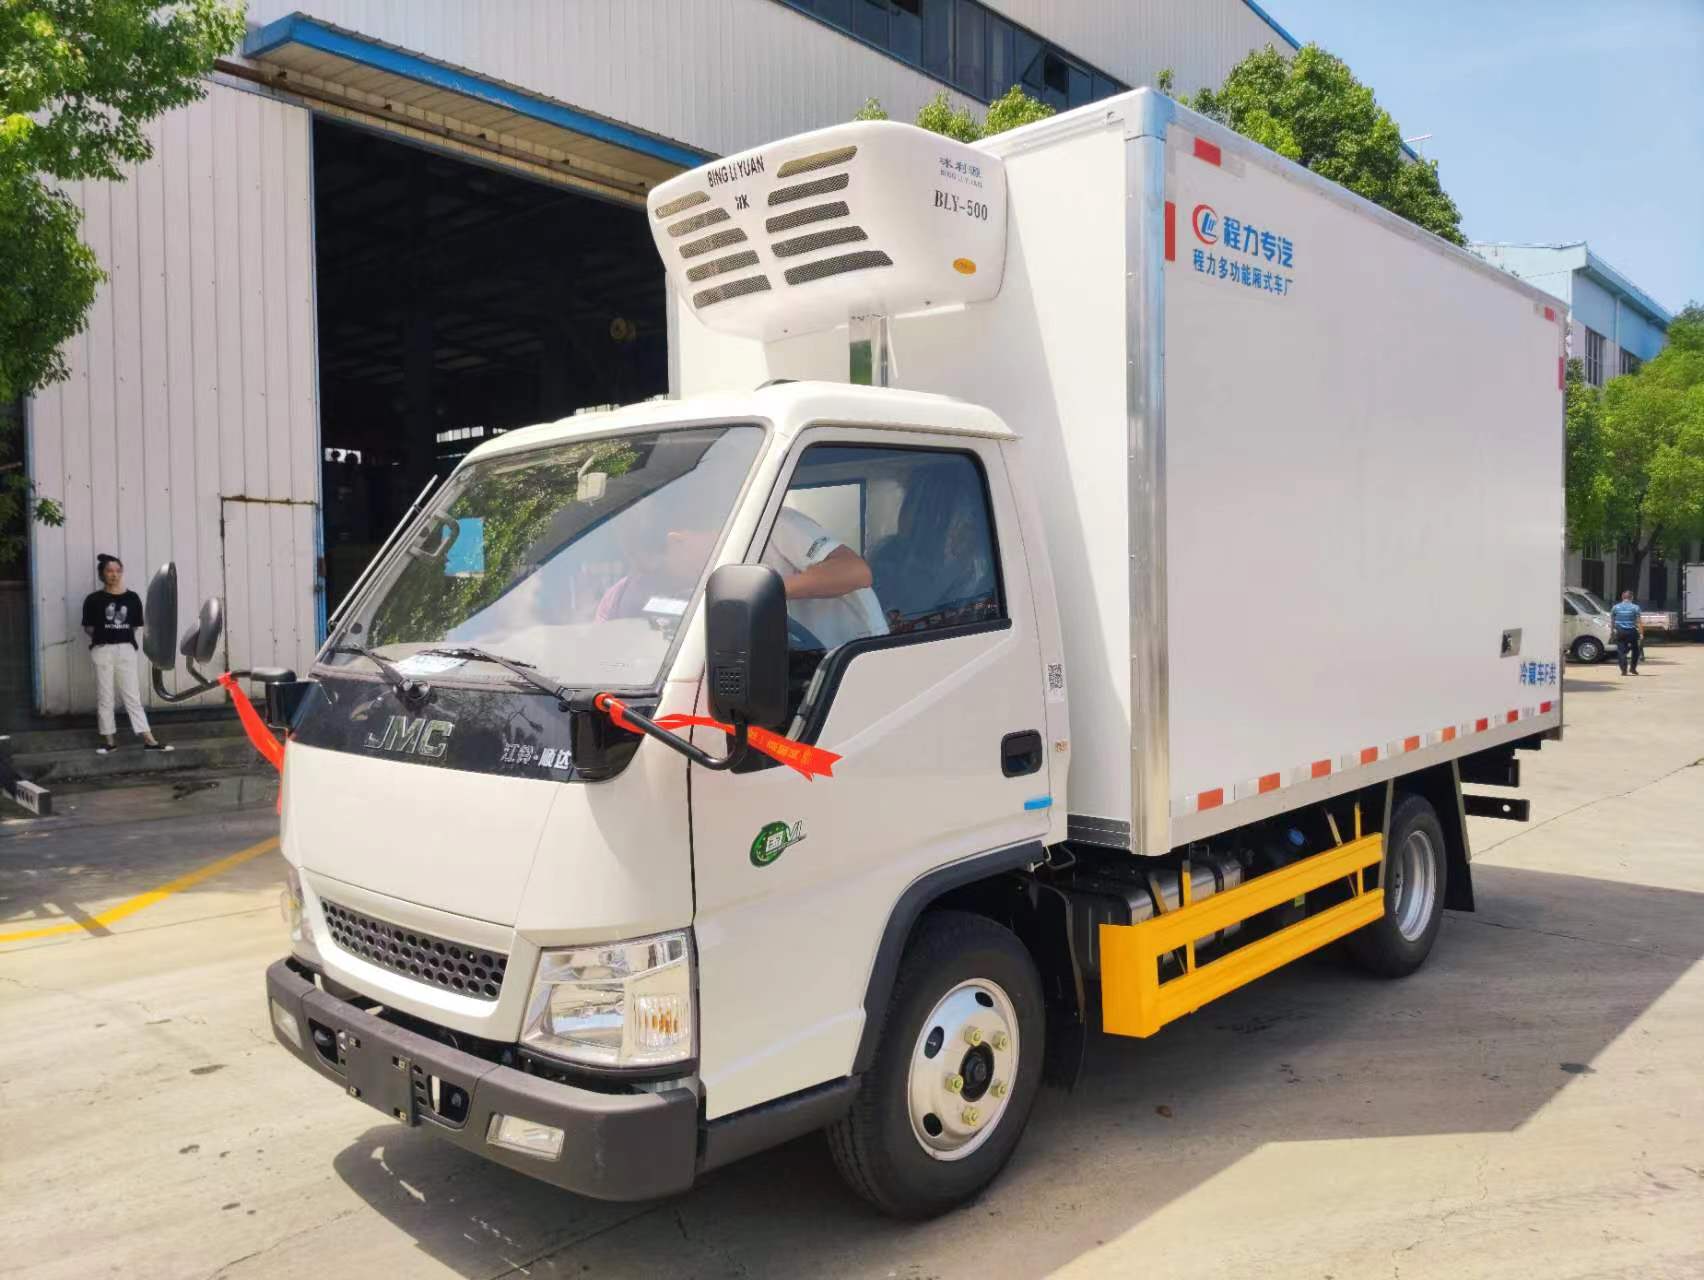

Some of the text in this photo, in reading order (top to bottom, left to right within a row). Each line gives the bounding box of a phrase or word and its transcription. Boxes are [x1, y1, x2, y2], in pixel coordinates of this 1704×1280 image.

[707, 166, 729, 188] BING
[737, 154, 765, 178] YUAN
[934, 189, 988, 221] BLY-500
[1223, 215, 1293, 269] 程力专汽
[1192, 247, 1294, 297] 程力多功能厢式车厂
[364, 714, 453, 758] JMC
